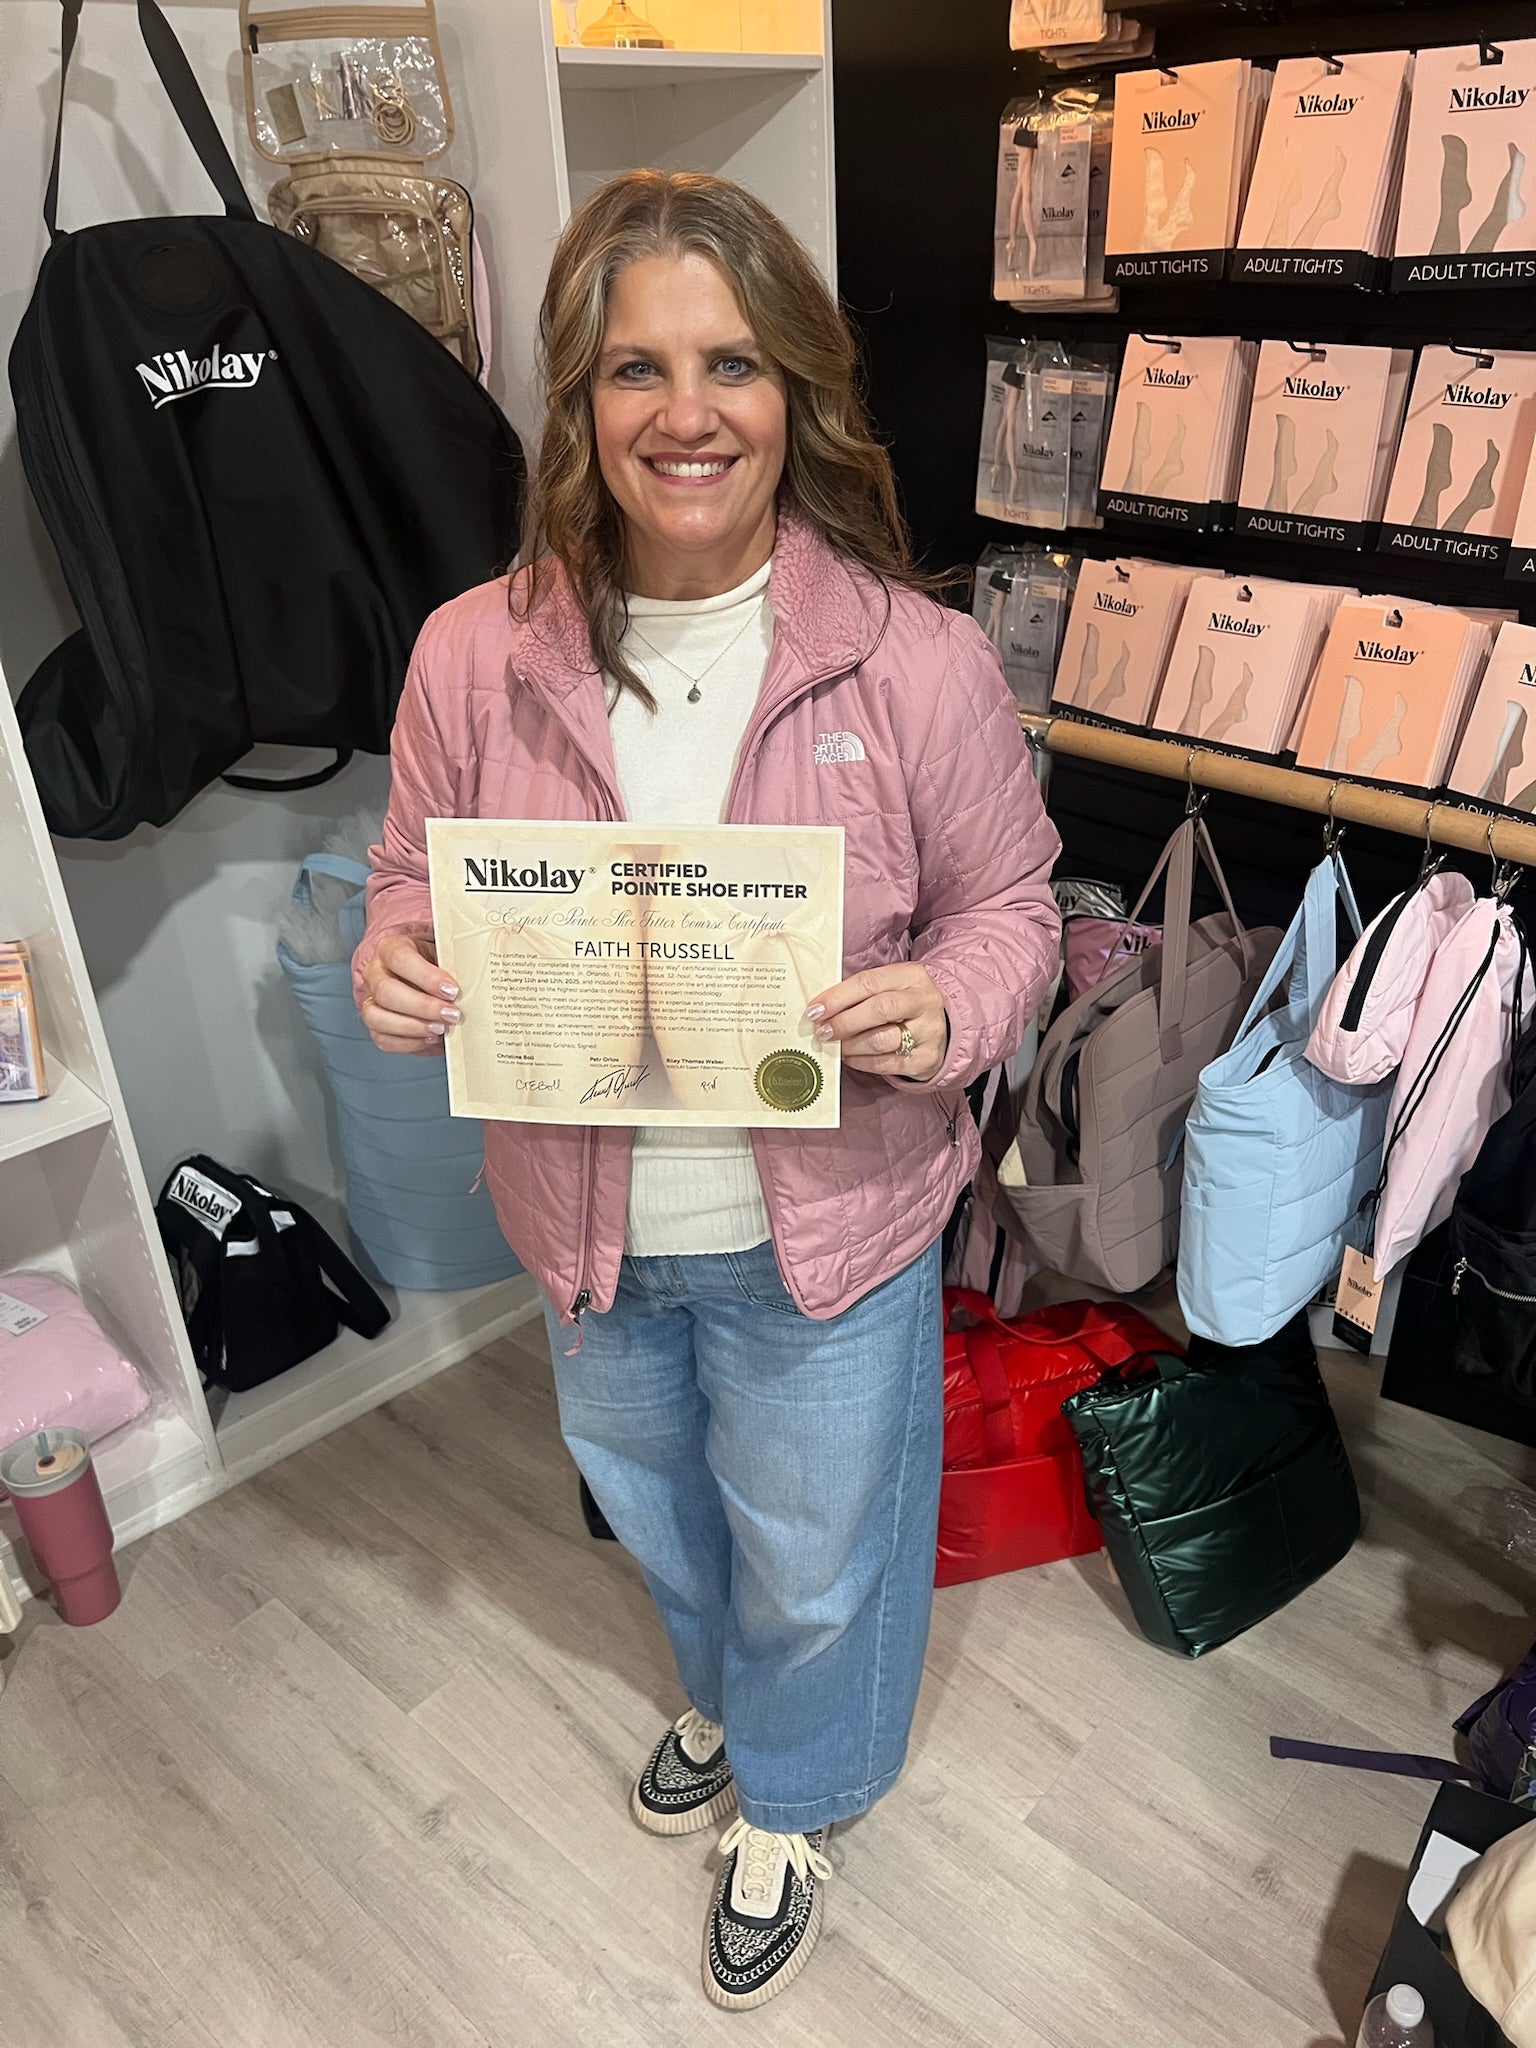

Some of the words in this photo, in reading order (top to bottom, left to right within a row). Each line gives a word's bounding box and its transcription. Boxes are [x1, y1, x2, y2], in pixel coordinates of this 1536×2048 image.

[1115, 260, 1158, 277] ADULT
[1160, 258, 1209, 275] TIGHTS
[1244, 258, 1291, 273] ADULT
[1293, 258, 1344, 275] TIGHTS
[1408, 263, 1468, 281] ADULT
[1471, 260, 1536, 279] TIGHTS
[1107, 498, 1147, 516] ADULT
[1147, 504, 1189, 522] TIGHTS
[1247, 516, 1293, 534] ADULT
[1295, 522, 1346, 542] TIGHTS
[1391, 532, 1442, 552] ADULT
[1444, 541, 1499, 560] TIGHTS
[818, 732, 843, 744] THE
[812, 742, 843, 755] ORTH
[815, 752, 845, 765] FACE
[611, 863, 707, 878] CERTIFIED
[612, 881, 682, 896] POINTE
[686, 883, 738, 897] SHOE
[743, 884, 808, 899] FITTER
[486, 907, 548, 934] Expert
[552, 906, 598, 927] Pointe
[602, 909, 636, 928] Shoe
[639, 910, 676, 929] Fitter
[681, 911, 723, 929] Course
[727, 911, 787, 938] Certificate
[575, 941, 630, 957] FAITH
[636, 942, 735, 960] TRUSSELL
